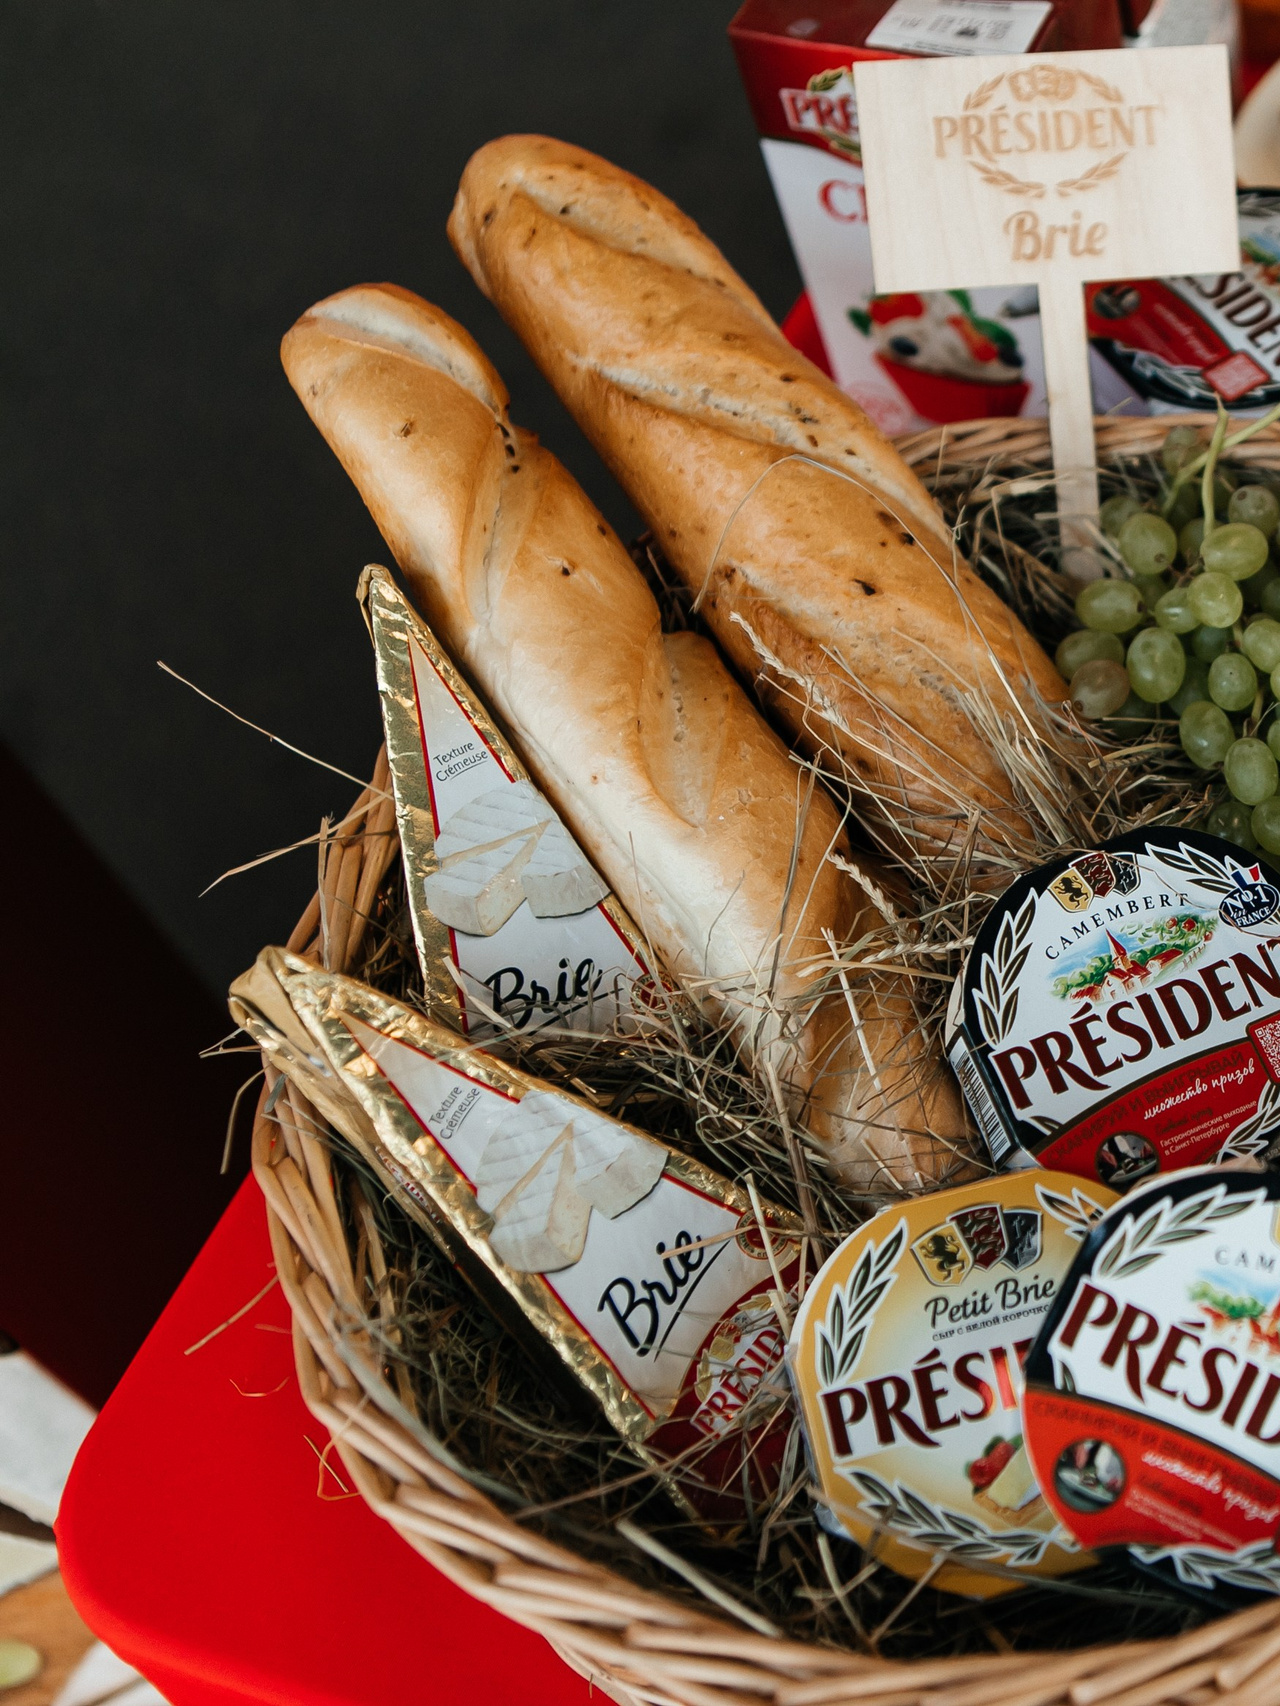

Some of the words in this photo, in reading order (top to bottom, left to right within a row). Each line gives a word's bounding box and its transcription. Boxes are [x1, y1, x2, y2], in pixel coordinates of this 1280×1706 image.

[932, 105, 1161, 163] PRÉSIDENT
[1003, 209, 1107, 263] Brie
[432, 740, 475, 768] Texture
[434, 748, 489, 783] Crémeuse
[1045, 891, 1192, 960] CAMEMBERT
[1235, 906, 1272, 926] FRANCE
[428, 1084, 463, 1127] Texture
[439, 1086, 481, 1140] Crémeuse
[1143, 1077, 1208, 1120] множество
[1211, 1057, 1256, 1094] призов
[1159, 1114, 1224, 1149] Гастрономические
[1222, 1099, 1258, 1124] выходные
[1170, 1121, 1231, 1154] Санкт-Петербурге
[597, 1229, 706, 1359] Brie
[923, 1289, 993, 1330] Petit
[994, 1274, 1057, 1311] Brie
[1001, 1304, 1051, 1324] КОРОЧКО
[823, 1339, 1034, 1459] PRÉSI
